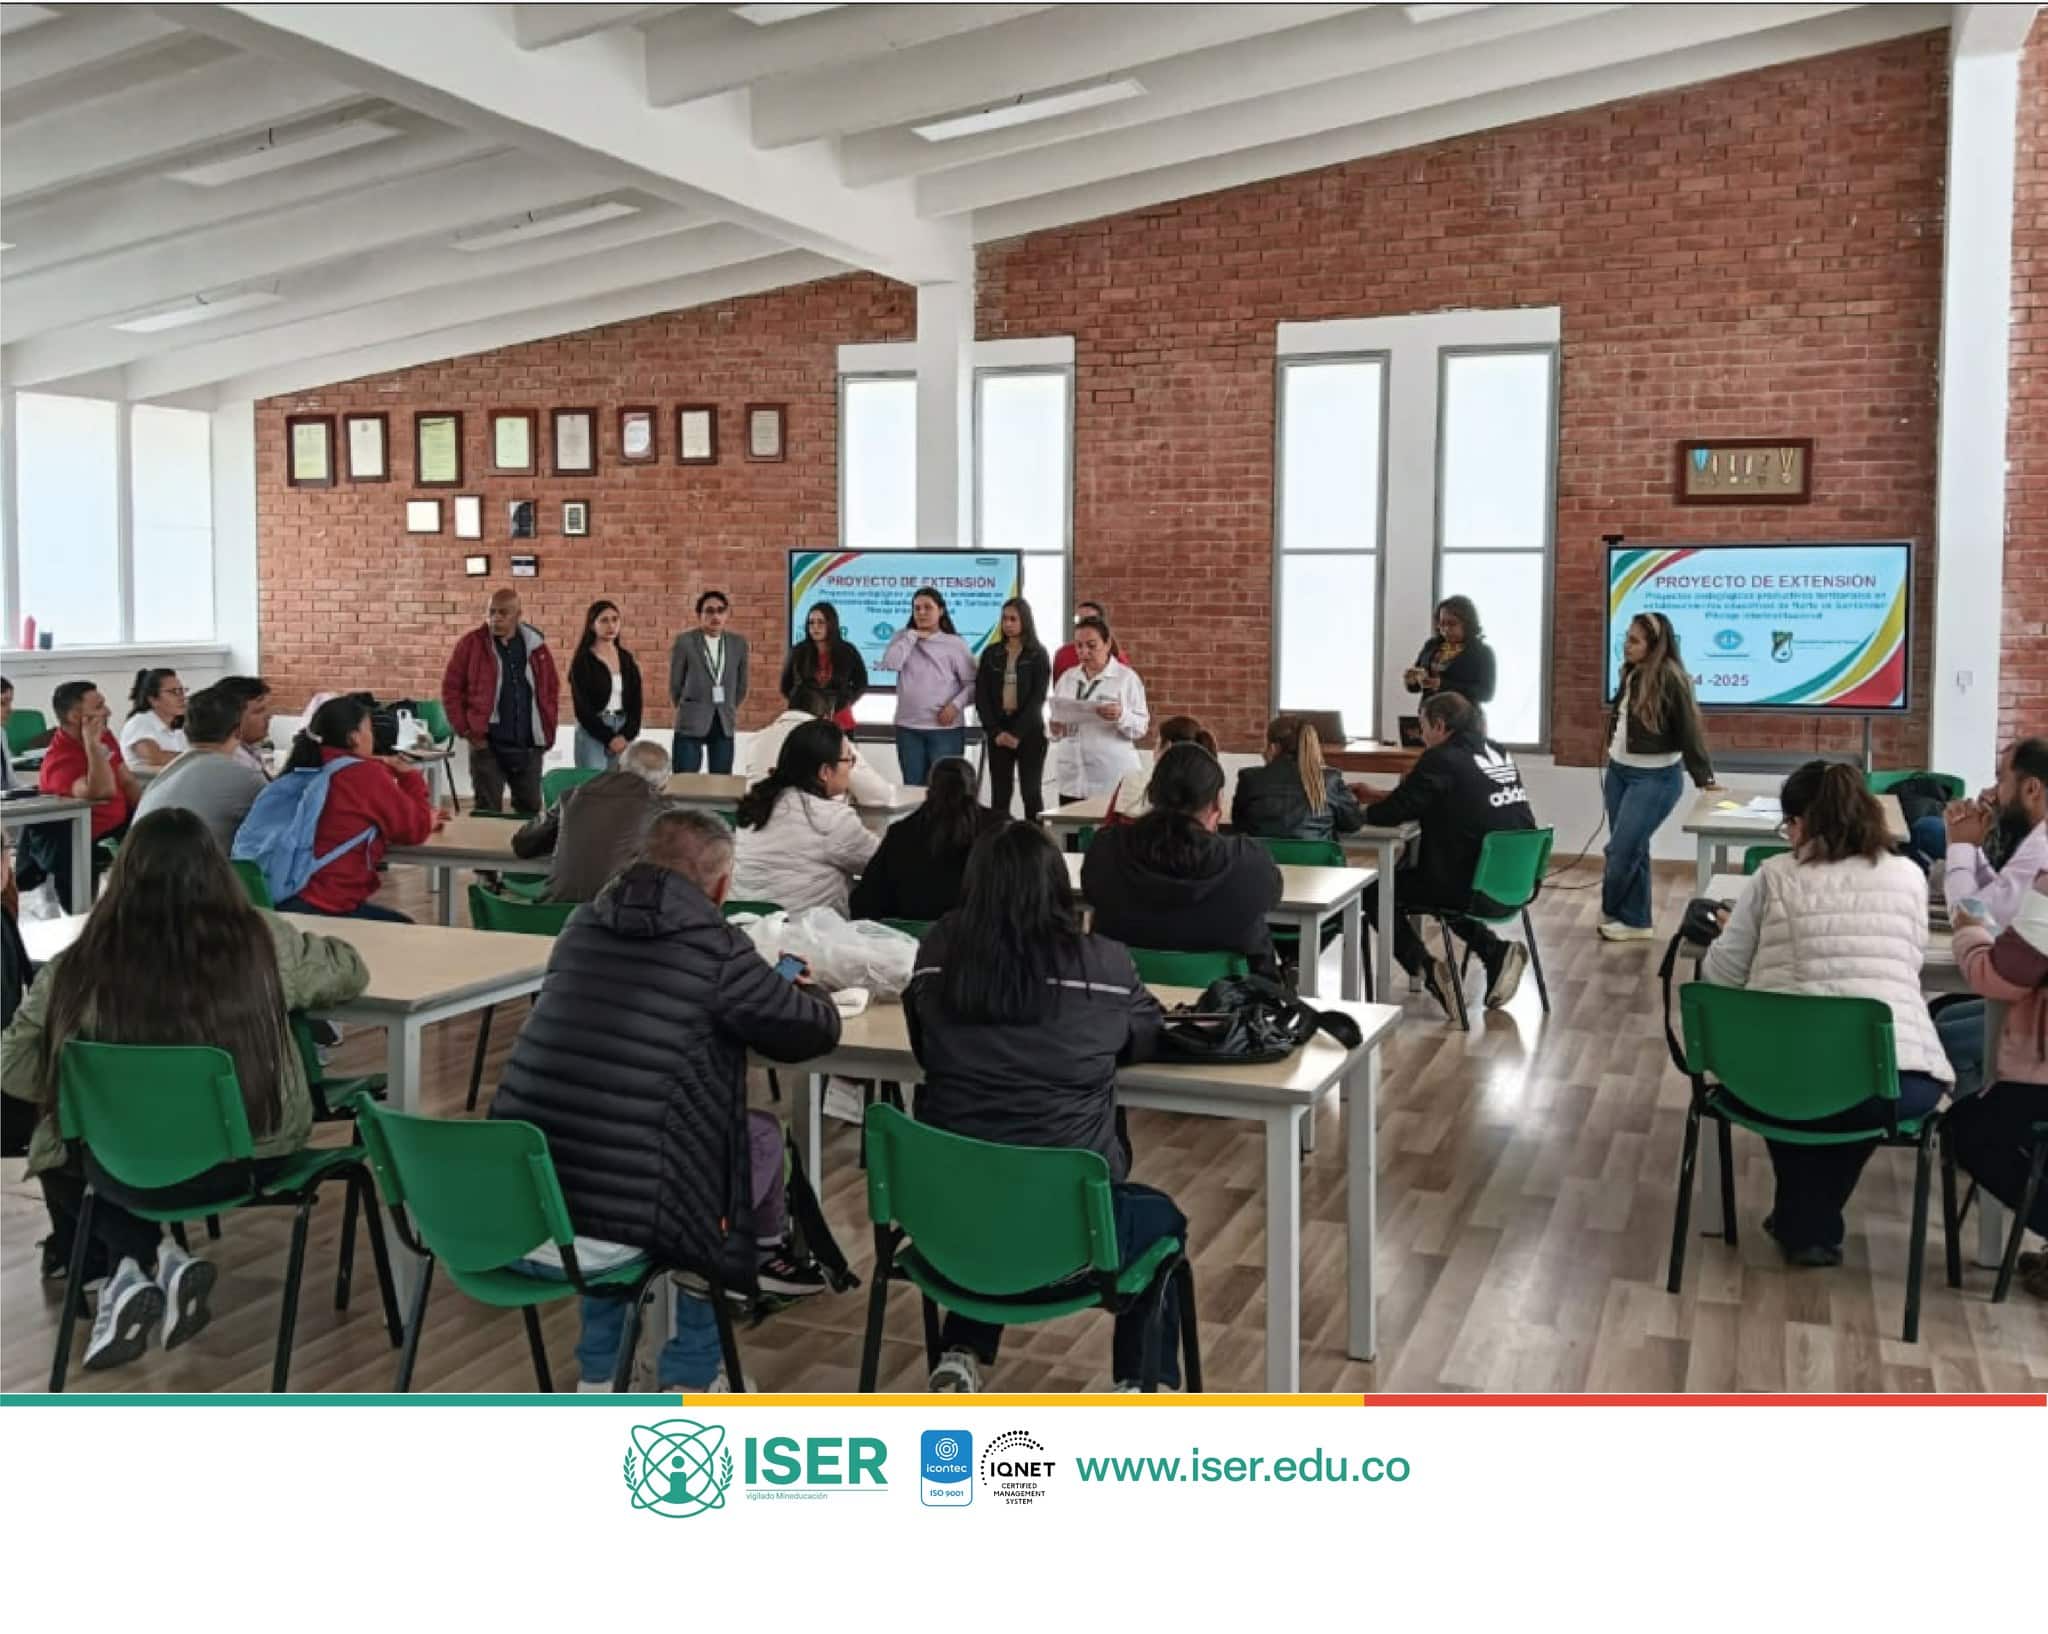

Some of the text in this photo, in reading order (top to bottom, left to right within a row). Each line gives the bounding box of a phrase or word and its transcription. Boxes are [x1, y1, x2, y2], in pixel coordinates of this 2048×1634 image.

[827, 576, 897, 588] PROYECTO
[902, 576, 917, 588] DE
[1656, 575, 1746, 588] PROYECTO
[1752, 575, 1774, 588] DE
